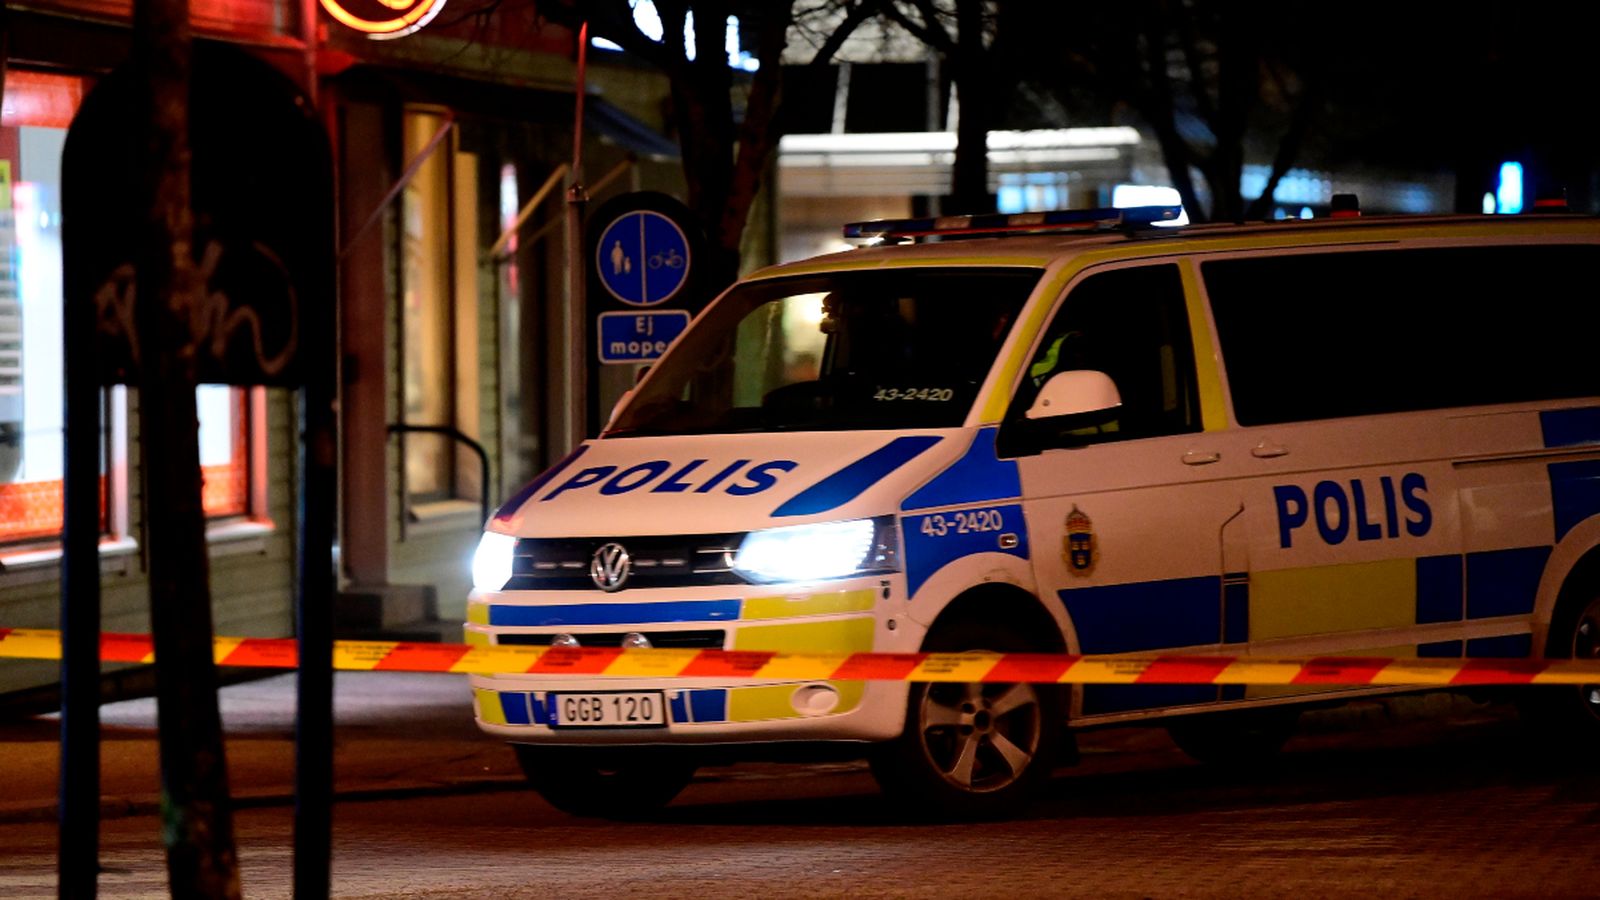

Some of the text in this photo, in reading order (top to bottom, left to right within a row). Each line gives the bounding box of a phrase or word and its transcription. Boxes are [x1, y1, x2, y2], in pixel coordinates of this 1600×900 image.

[635, 315, 654, 336] Ej
[609, 340, 671, 357] mope
[872, 385, 954, 401] 43-2420
[540, 459, 798, 502] POLIS
[920, 509, 1003, 537] 43-2420
[1273, 473, 1432, 548] POLIS
[564, 696, 652, 722] GGB 120
